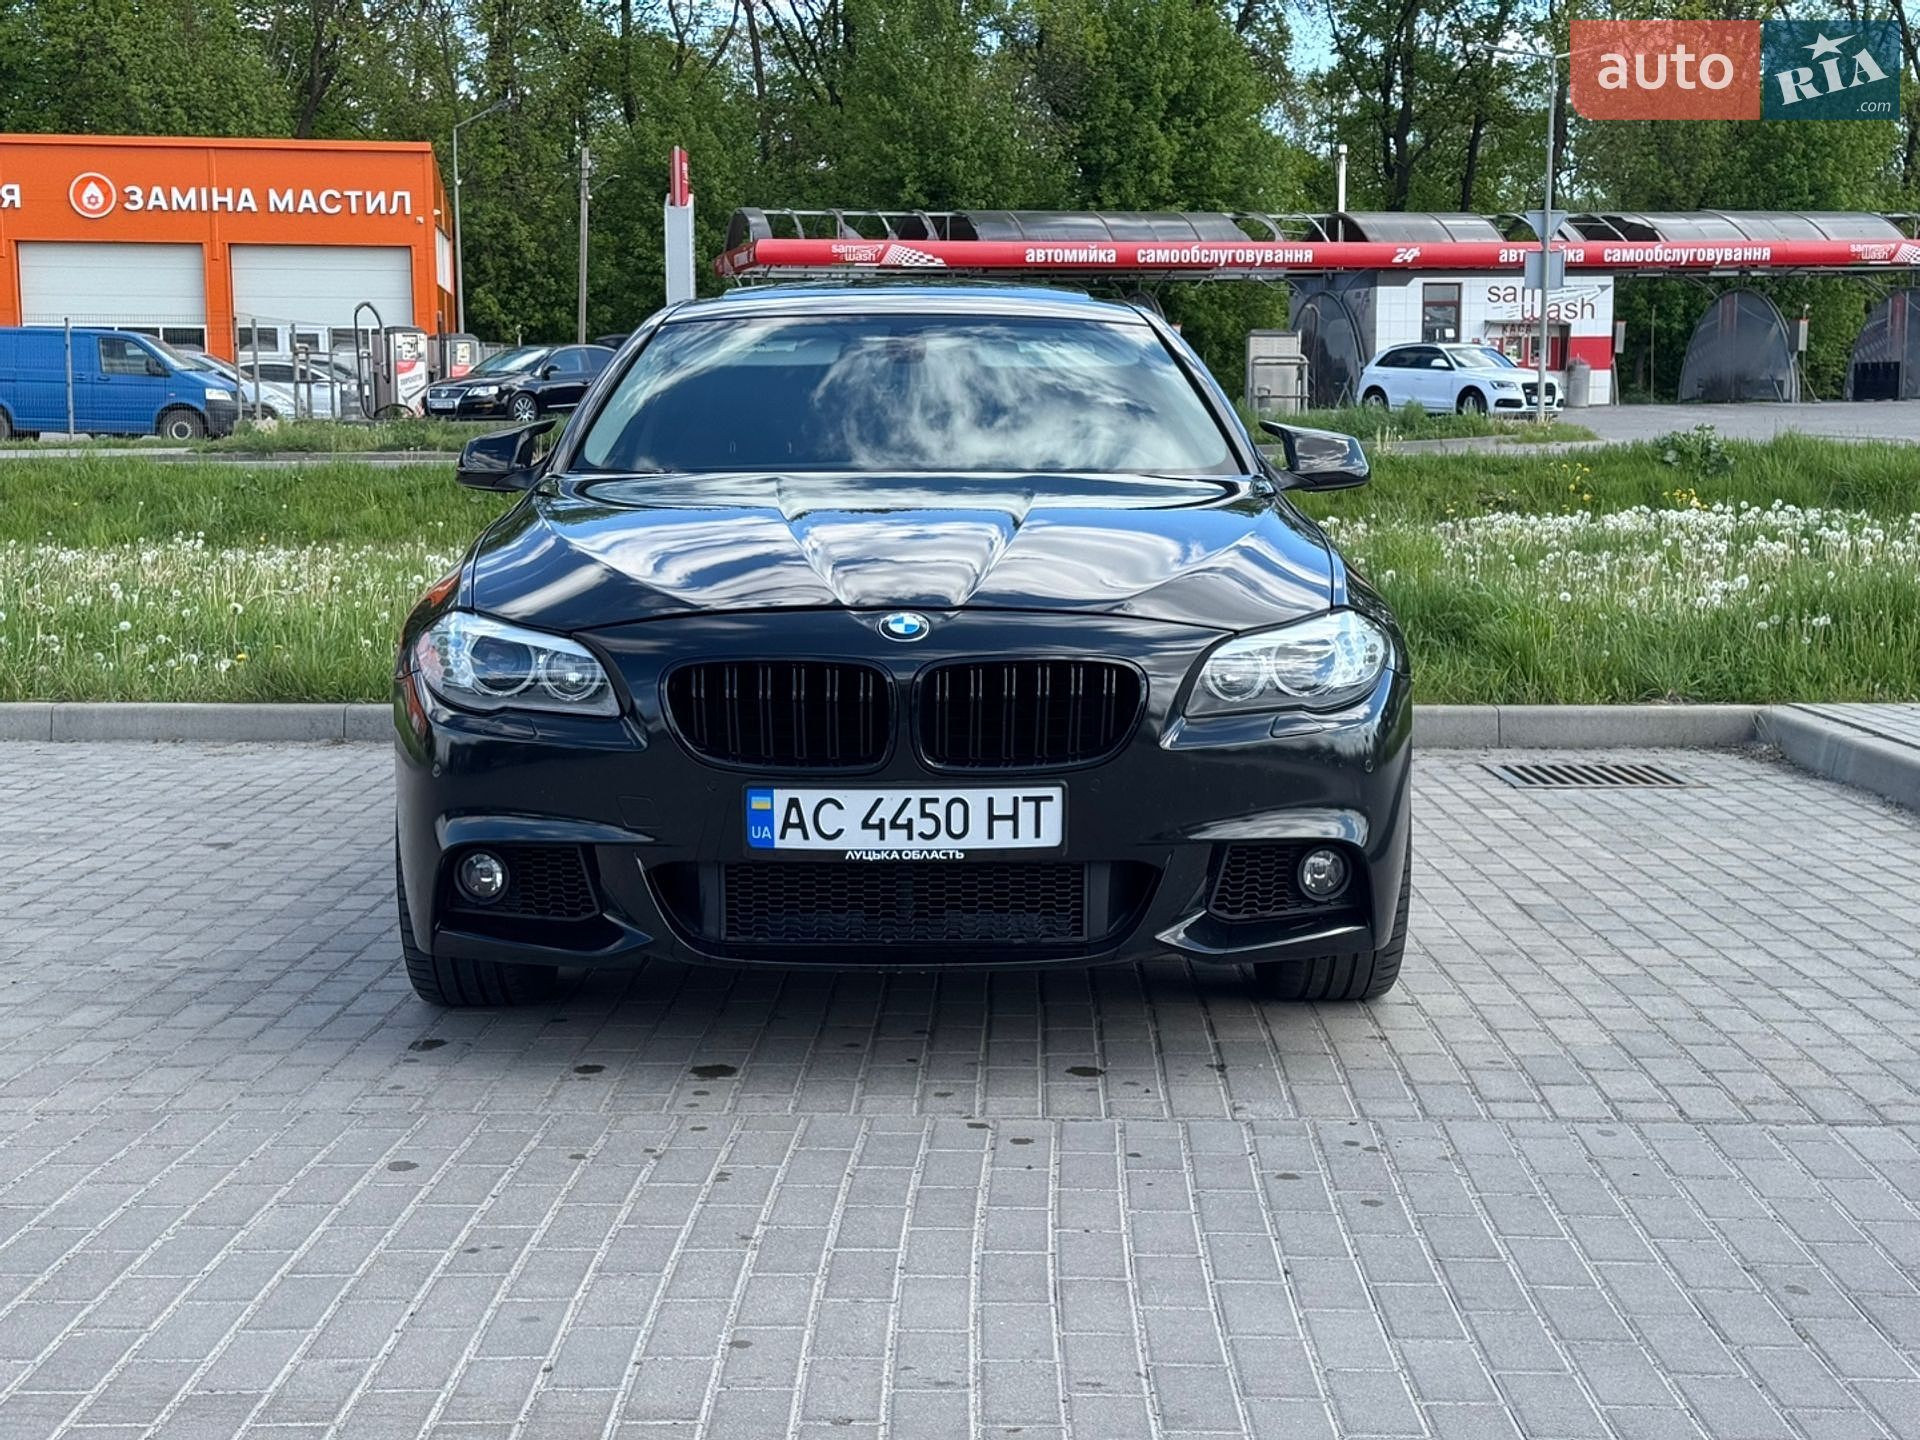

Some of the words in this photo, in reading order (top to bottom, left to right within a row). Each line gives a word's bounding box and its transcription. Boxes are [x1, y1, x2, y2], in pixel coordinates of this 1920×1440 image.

[123, 185, 258, 213] ЗАМІНА
[268, 188, 412, 215] МАСТИЛ
[1025, 245, 1117, 263] автомийка
[1136, 245, 1314, 266] самообслуговування
[1603, 245, 1771, 265] самообслуговування
[751, 826, 772, 839] UA
[779, 797, 845, 841] AC
[861, 797, 970, 841] 4450
[987, 796, 1054, 840] HT
[845, 850, 900, 862] ЛУЦЬКА
[902, 850, 965, 861] ОБЛАСТЬ
